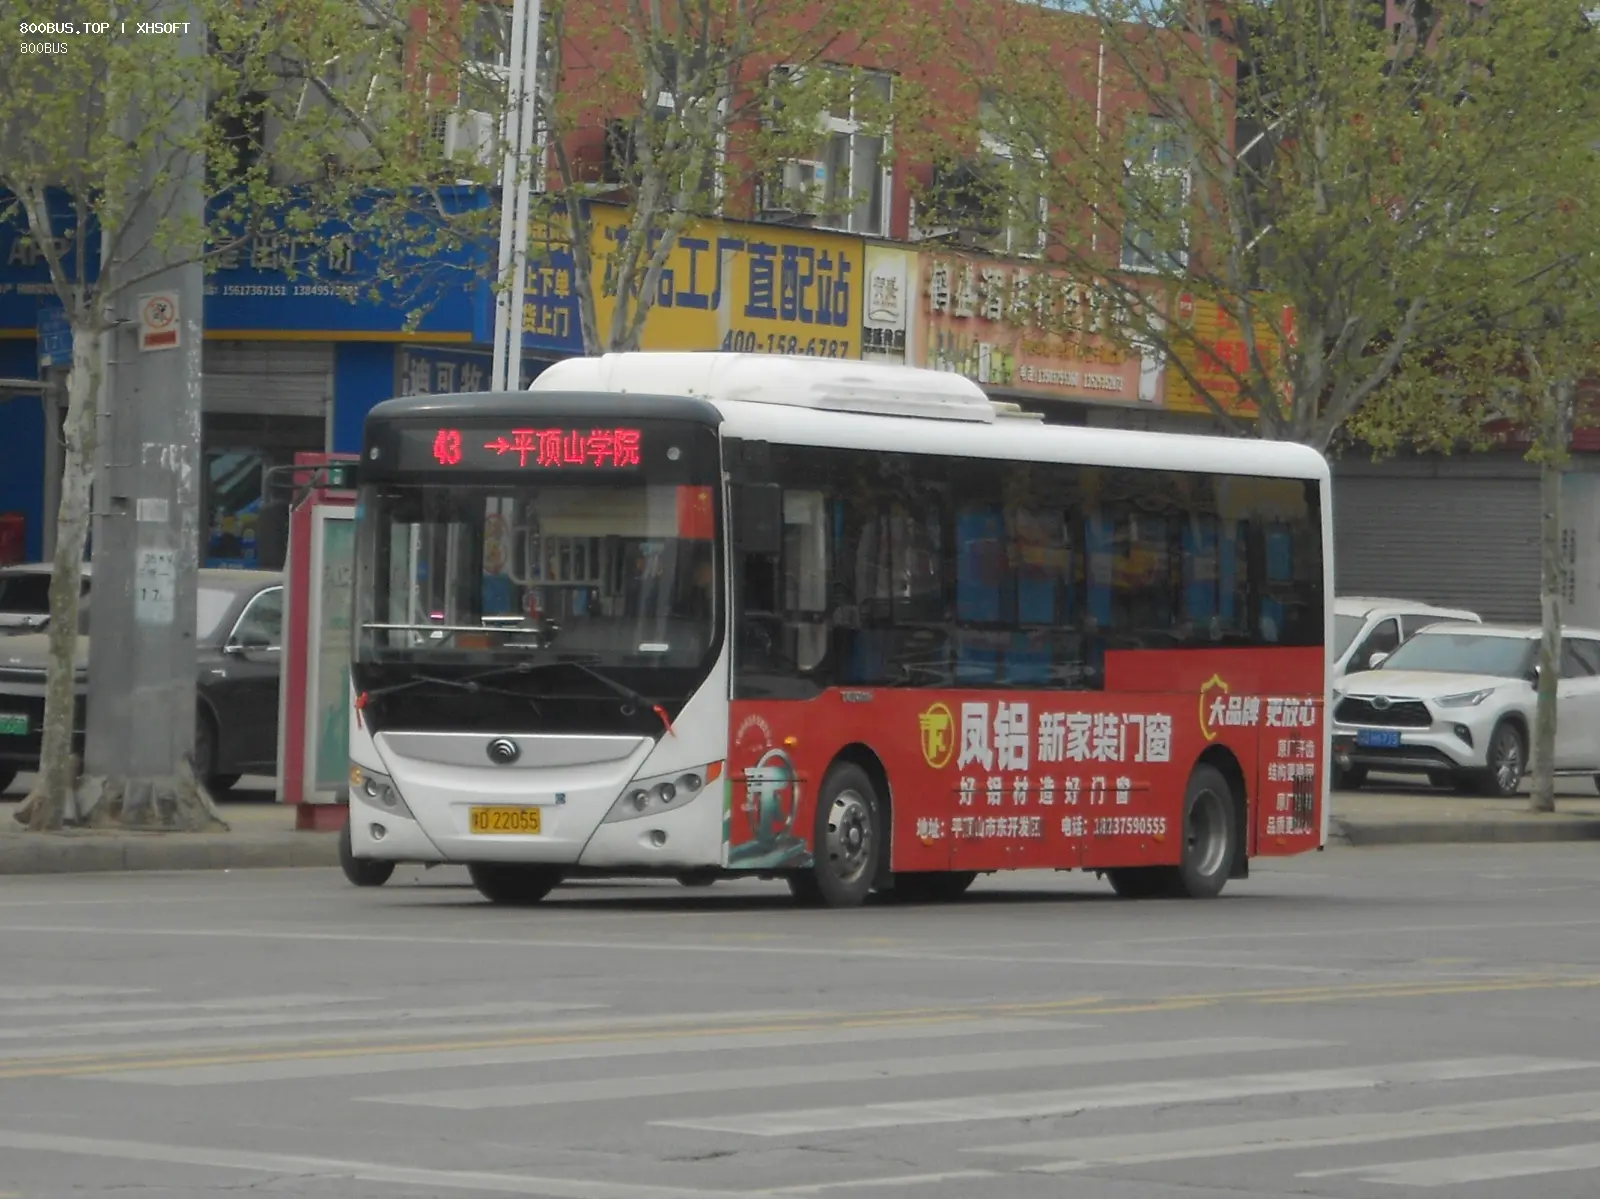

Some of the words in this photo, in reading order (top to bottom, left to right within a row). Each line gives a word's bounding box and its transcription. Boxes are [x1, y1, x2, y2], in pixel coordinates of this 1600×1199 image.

[721, 328, 850, 359] 400-158-6787
[432, 429, 462, 465] 43
[508, 428, 642, 467] 平顶山学院
[1208, 696, 1260, 726] 大品牌
[1266, 698, 1316, 728] 更放心
[957, 700, 1030, 771] 凤铝
[1038, 711, 1172, 763] 新家装门窗
[493, 811, 538, 830] 22055
